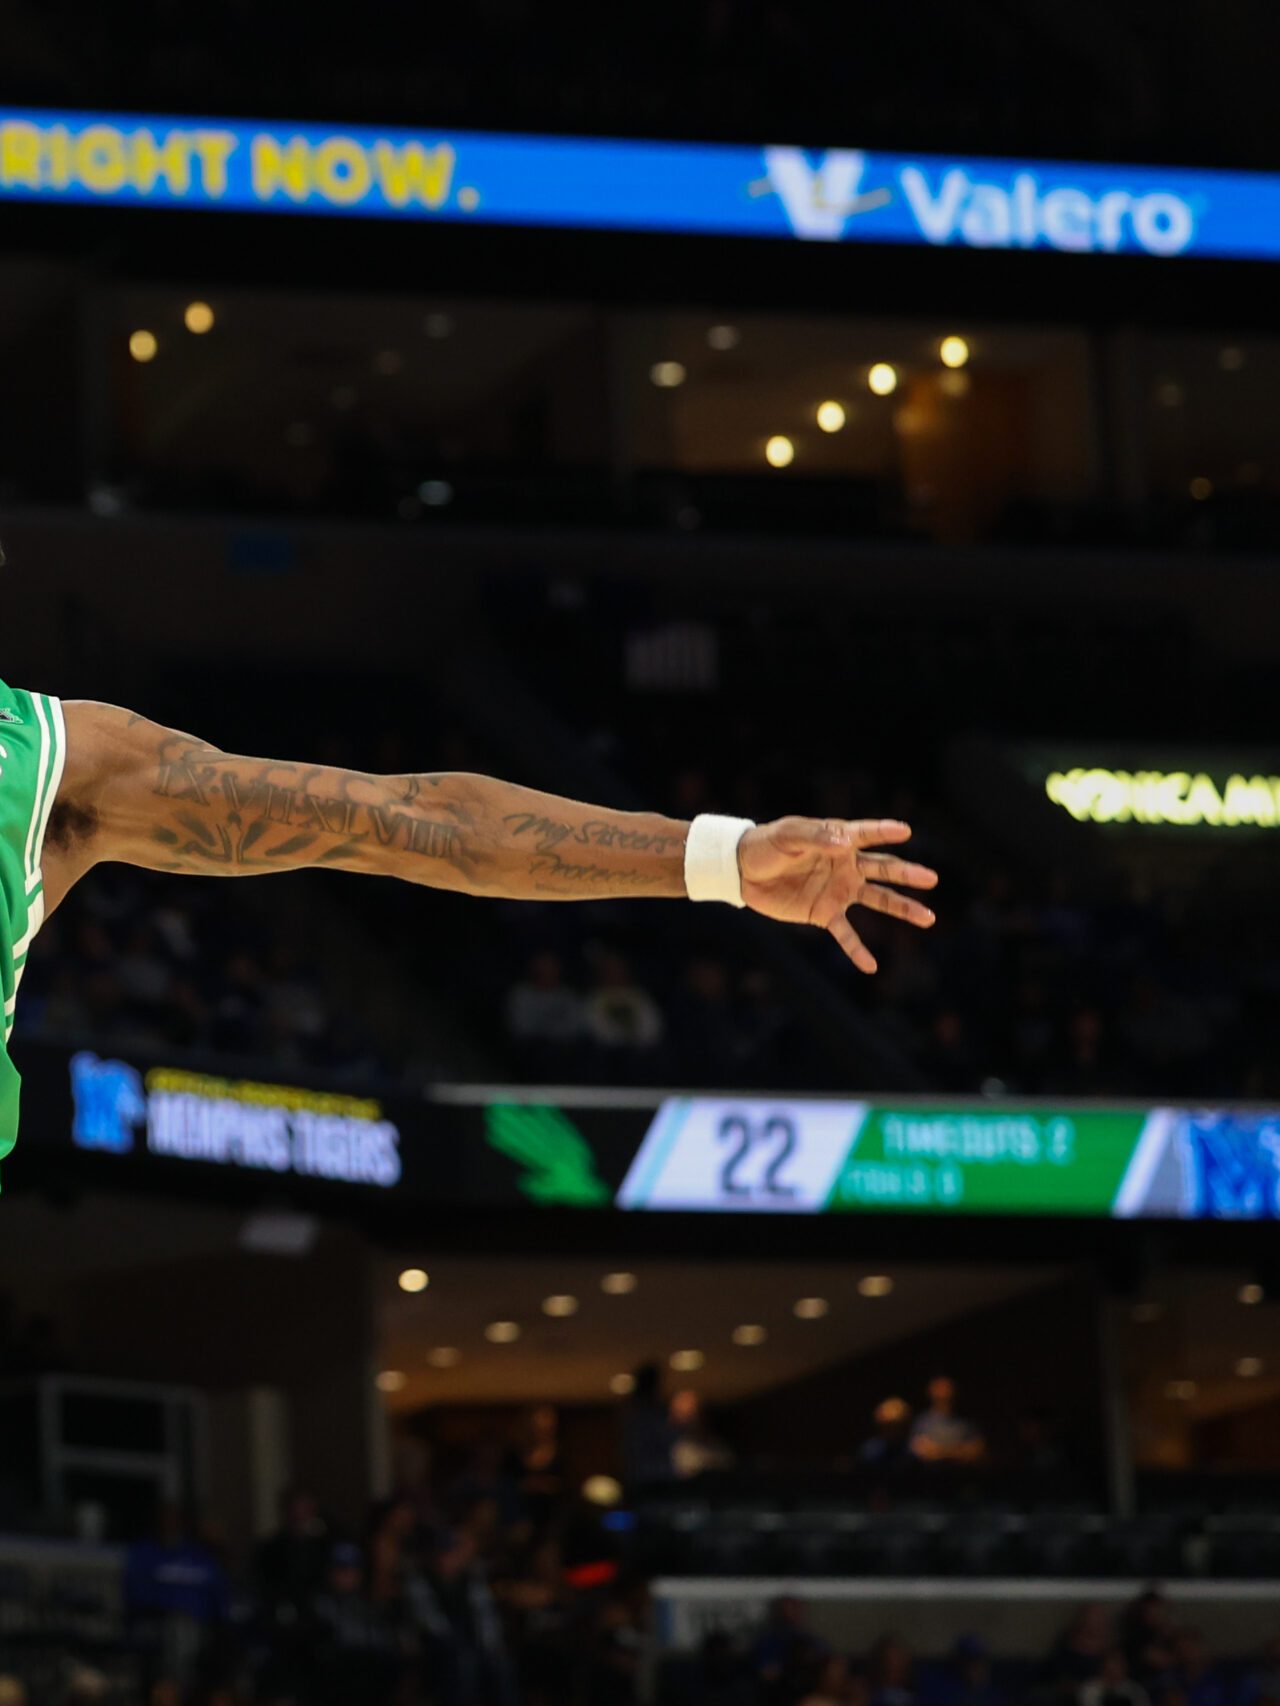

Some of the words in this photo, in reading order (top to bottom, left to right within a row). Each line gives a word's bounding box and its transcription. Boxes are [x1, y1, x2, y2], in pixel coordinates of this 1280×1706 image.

[250, 133, 481, 212] NOW.
[900, 166, 1195, 257] Valero
[719, 1114, 797, 1197] 22
